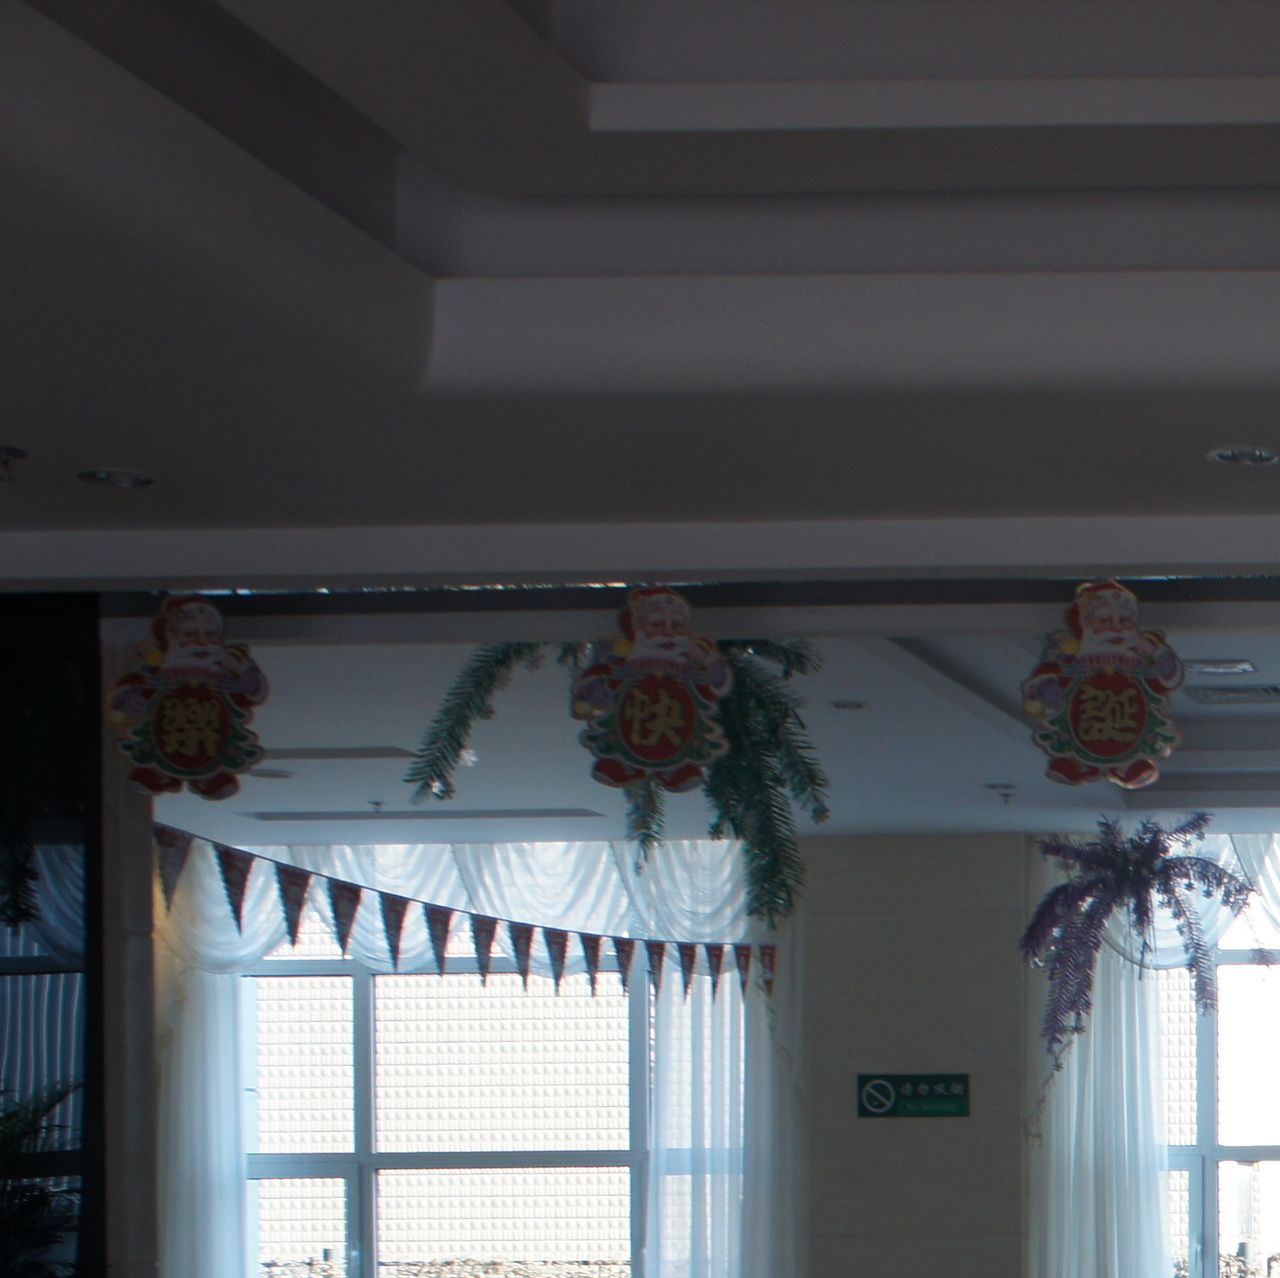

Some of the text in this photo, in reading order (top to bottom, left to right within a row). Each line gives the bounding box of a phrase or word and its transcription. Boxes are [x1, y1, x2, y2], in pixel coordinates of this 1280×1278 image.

[162, 697, 221, 757] 樂
[624, 688, 685, 747] 快
[1078, 684, 1139, 741] 誕
